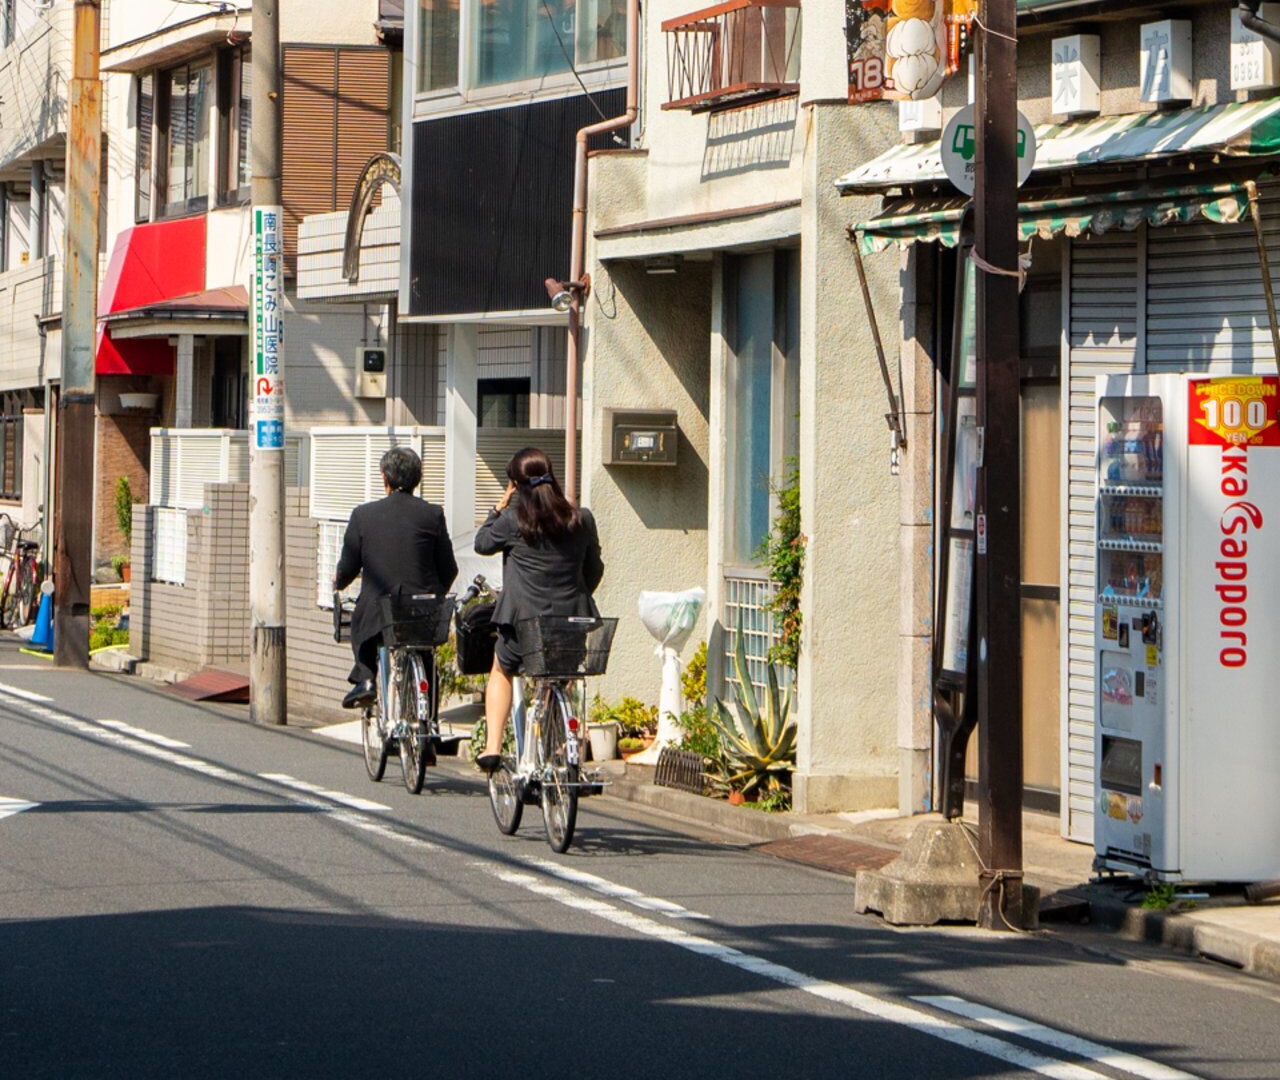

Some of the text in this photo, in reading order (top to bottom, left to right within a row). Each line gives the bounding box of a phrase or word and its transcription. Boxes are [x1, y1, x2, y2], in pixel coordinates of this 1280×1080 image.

[850, 58, 883, 91] 18
[1054, 44, 1079, 106] 米
[1195, 383, 1277, 397] PRICE DOWN
[1201, 398, 1267, 430] 100
[1225, 431, 1248, 444] YEN
